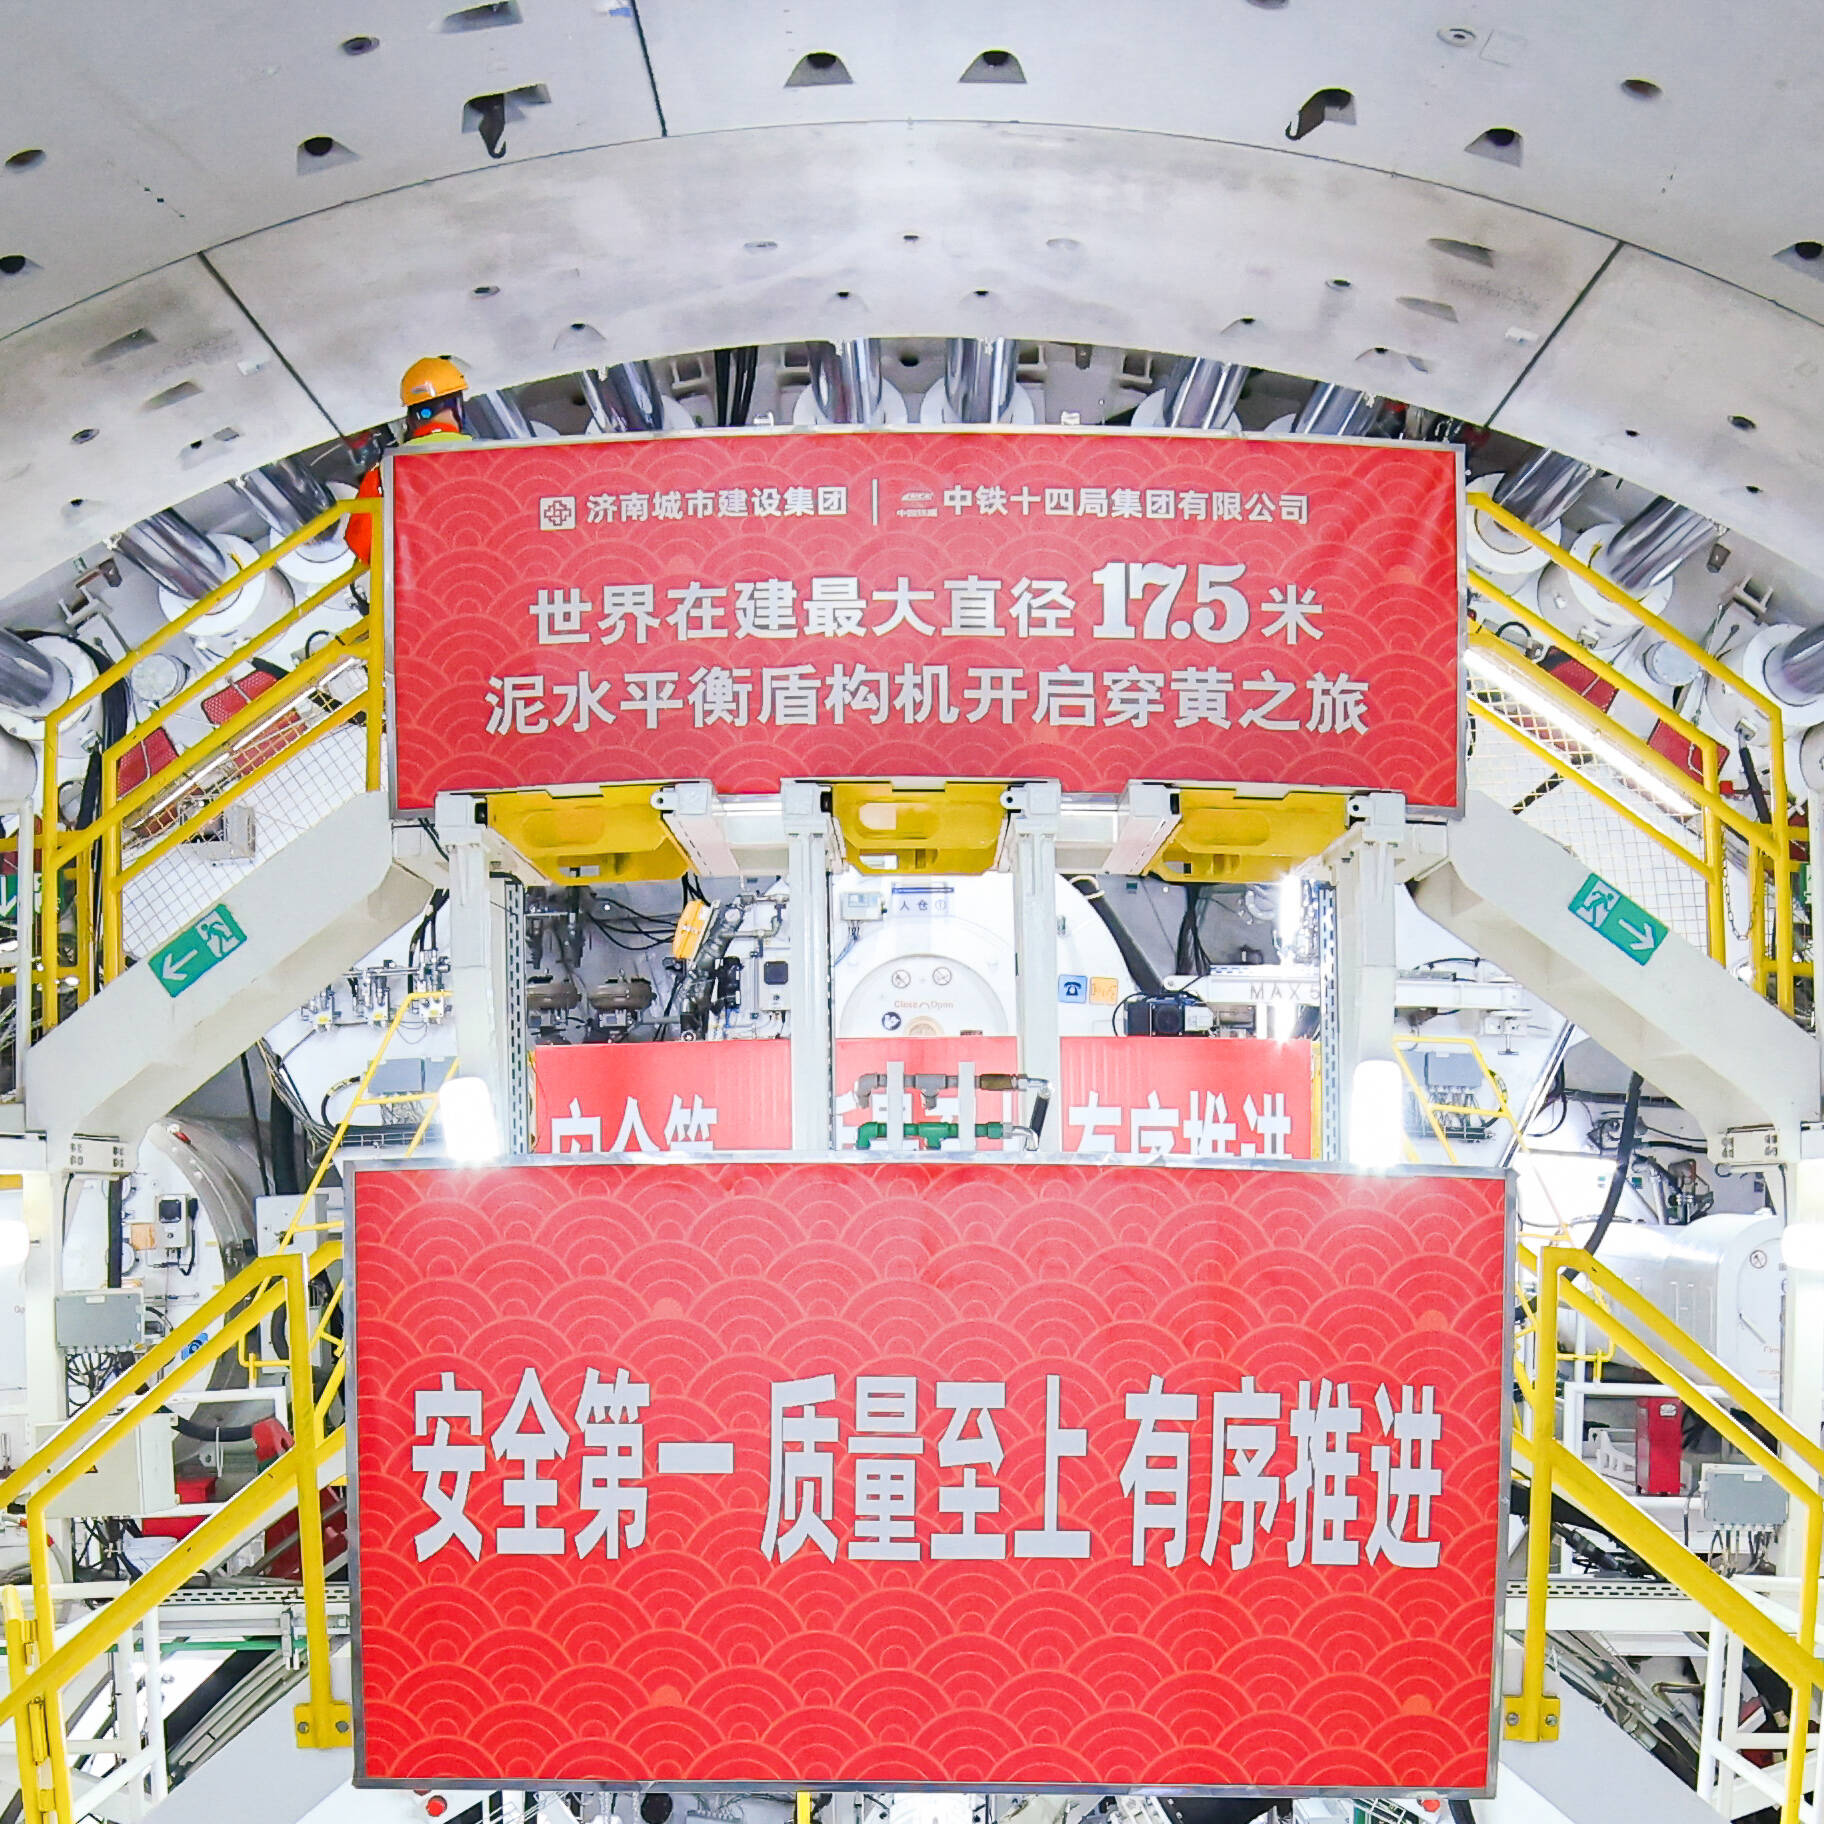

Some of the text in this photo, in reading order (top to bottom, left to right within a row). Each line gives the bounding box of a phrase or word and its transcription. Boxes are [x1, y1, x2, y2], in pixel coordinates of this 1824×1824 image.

[587, 486, 848, 523] 济南城市建设集团
[943, 484, 1309, 525] 中铁十四局集团有限公司
[484, 661, 1370, 736] 泥水平衡盾构机开启穿黄之旅
[411, 1367, 1443, 1572] 安全第一 质量至上 有序推进
